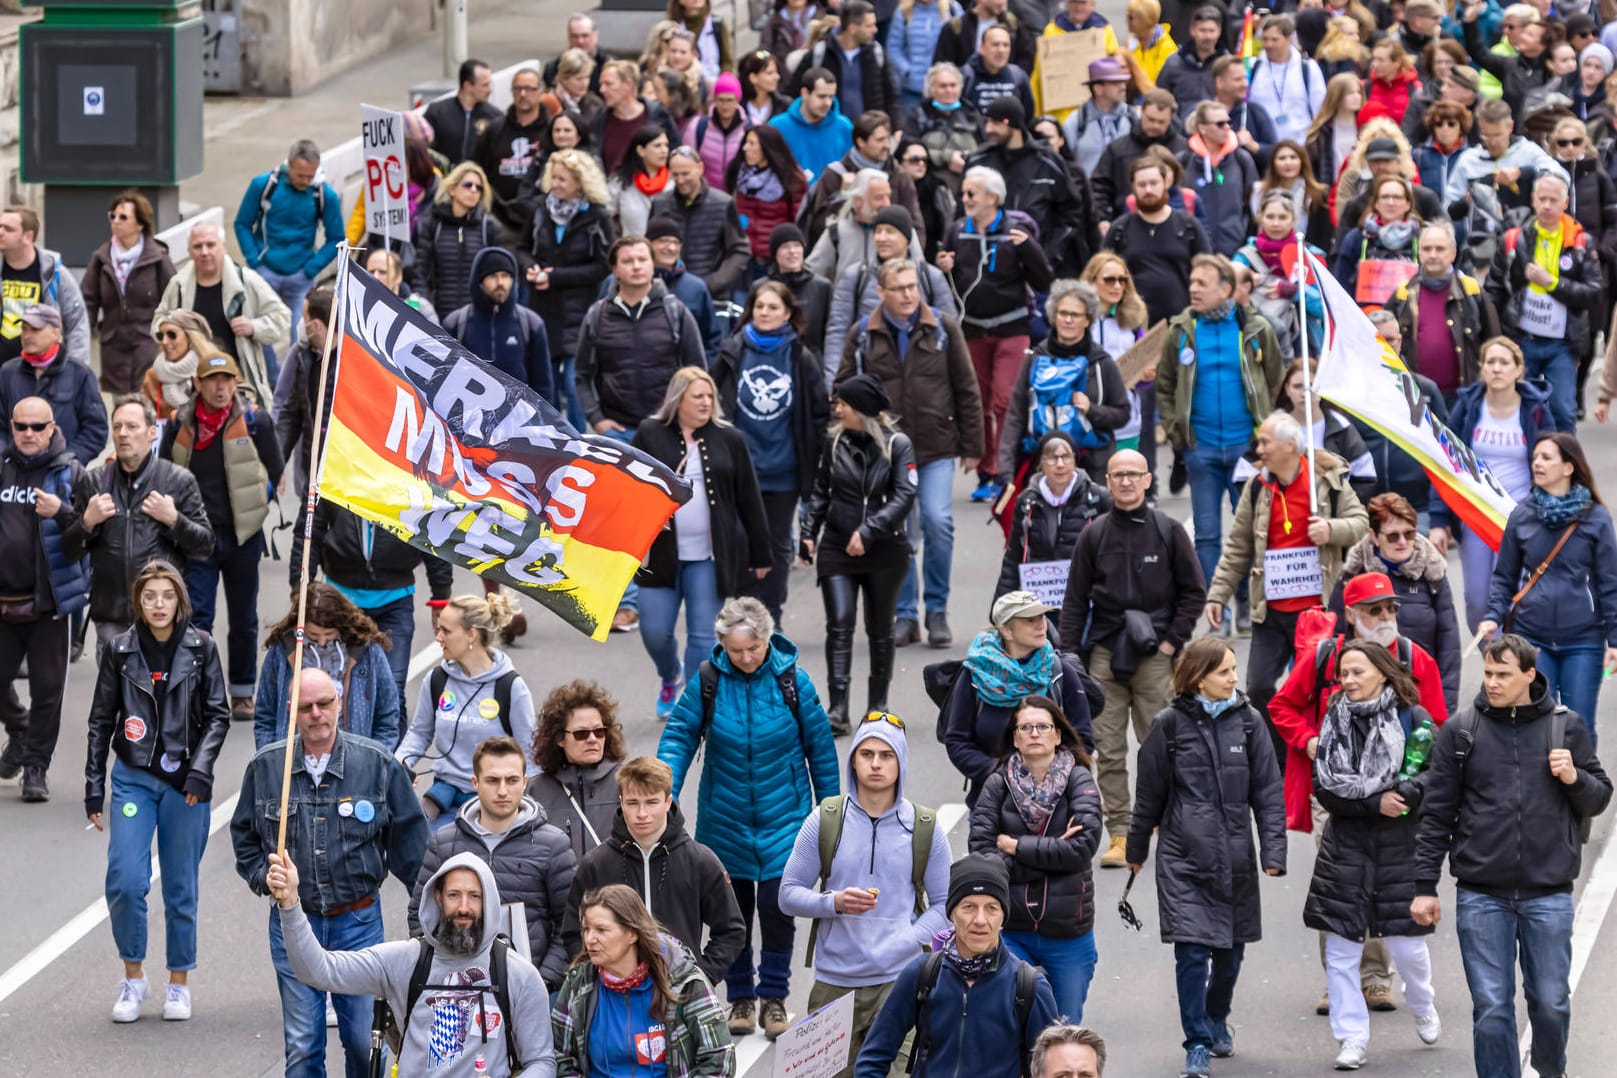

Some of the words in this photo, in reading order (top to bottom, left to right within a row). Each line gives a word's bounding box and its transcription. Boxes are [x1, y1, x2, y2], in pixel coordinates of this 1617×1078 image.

[362, 117, 395, 148] FUCK
[366, 154, 404, 203] PC
[373, 207, 408, 229] SYTEM!
[348, 272, 673, 496] MERKEL
[385, 385, 596, 527] MUSS
[398, 484, 566, 584] WEG
[1264, 549, 1317, 561] FRANKFURT
[1286, 561, 1308, 572] FÜR
